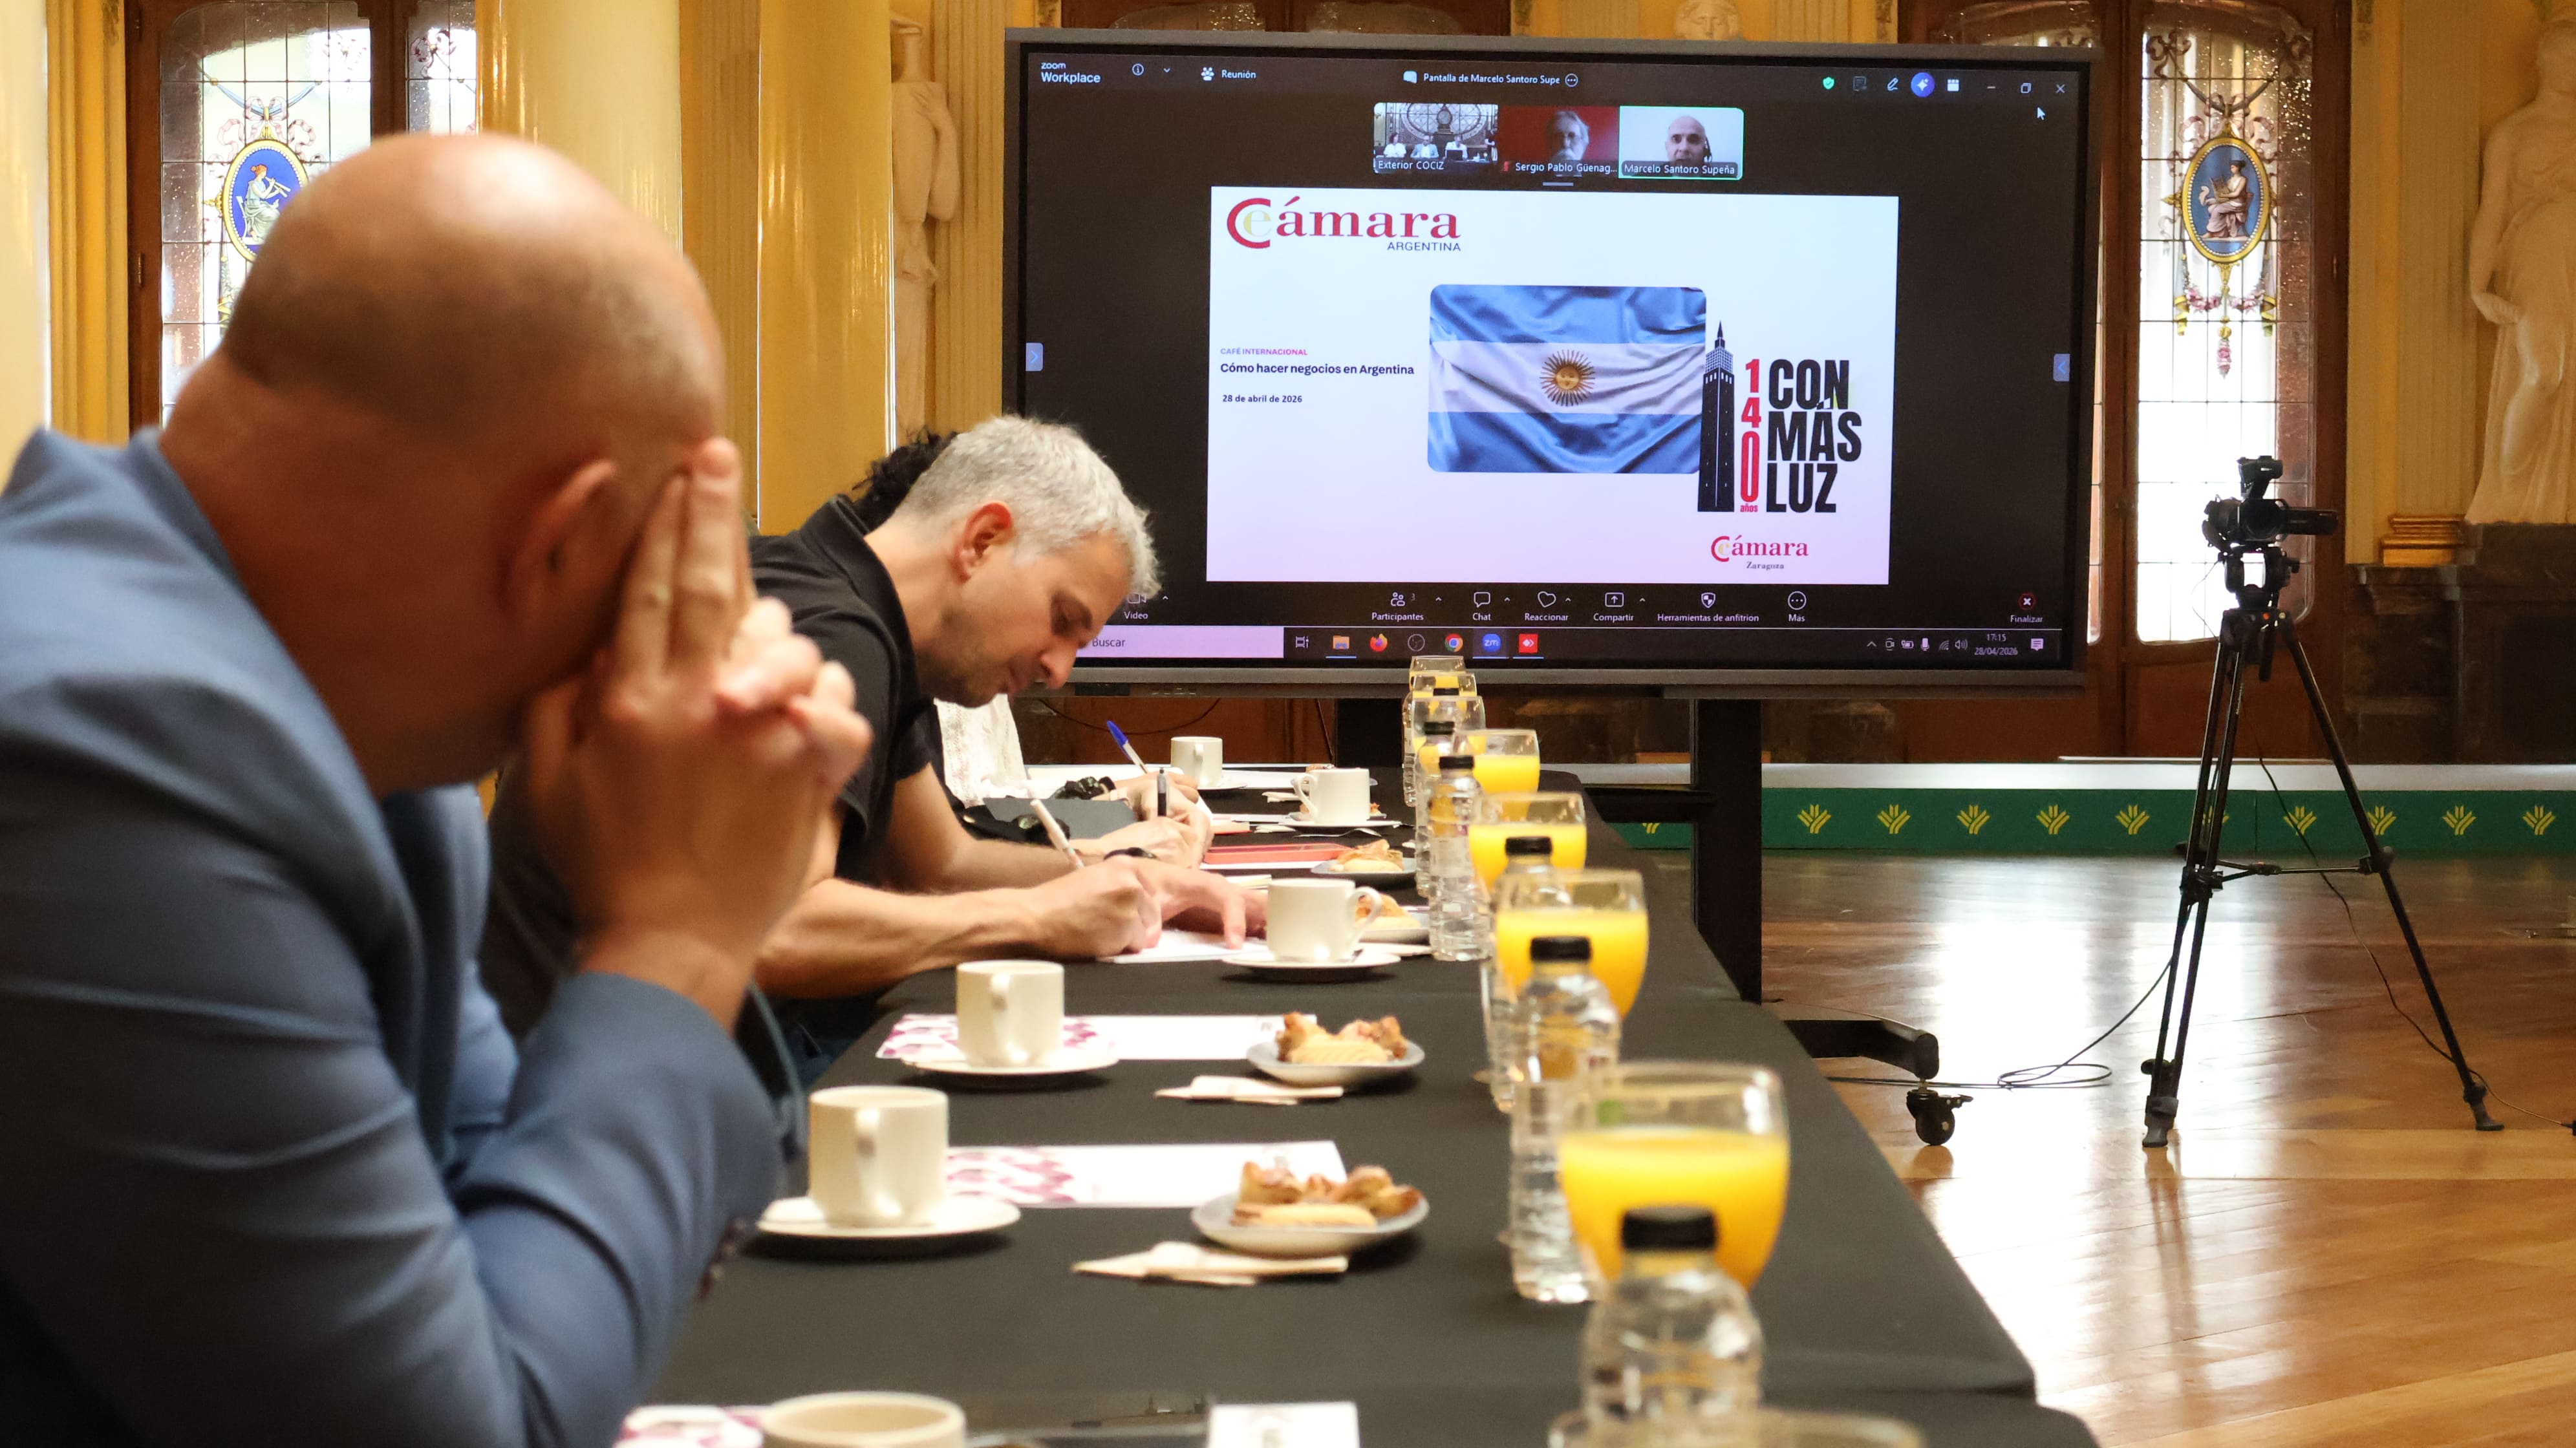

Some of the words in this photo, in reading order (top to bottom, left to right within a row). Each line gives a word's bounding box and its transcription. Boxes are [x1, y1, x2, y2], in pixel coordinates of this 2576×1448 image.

[1041, 72, 1100, 84] Workplace
[1221, 70, 1256, 79] Reunión
[1424, 72, 1456, 82] Pantalla
[1458, 74, 1469, 82] de
[1471, 74, 1504, 83] Marcelo
[1506, 74, 1538, 83] Santoro
[1540, 75, 1560, 85] Supe
[1378, 160, 1413, 169] Exterior
[1416, 161, 1444, 170] COCIZ
[1516, 162, 1545, 173] Sergio
[1547, 163, 1573, 173] Pablo
[1624, 164, 1661, 174] Marcelo
[1664, 165, 1699, 175] Santoro
[1702, 165, 1735, 177] Supeña
[1387, 242, 1461, 251] ARGENTINA
[1220, 362, 1254, 373] Cómo
[1256, 363, 1288, 373] hacer
[1291, 364, 1341, 376] negocios
[1359, 365, 1415, 376] Argentina
[1768, 359, 1849, 410] CON
[1766, 463, 1838, 513] LUZ
[1746, 561, 1785, 570] Zaragoza
[1371, 613, 1424, 622] Participantes
[1593, 613, 1634, 623] Compartir
[1092, 637, 1126, 647] Buscar
[1986, 634, 2006, 642] 17:15
[1974, 647, 2018, 655] 28/04/2026
